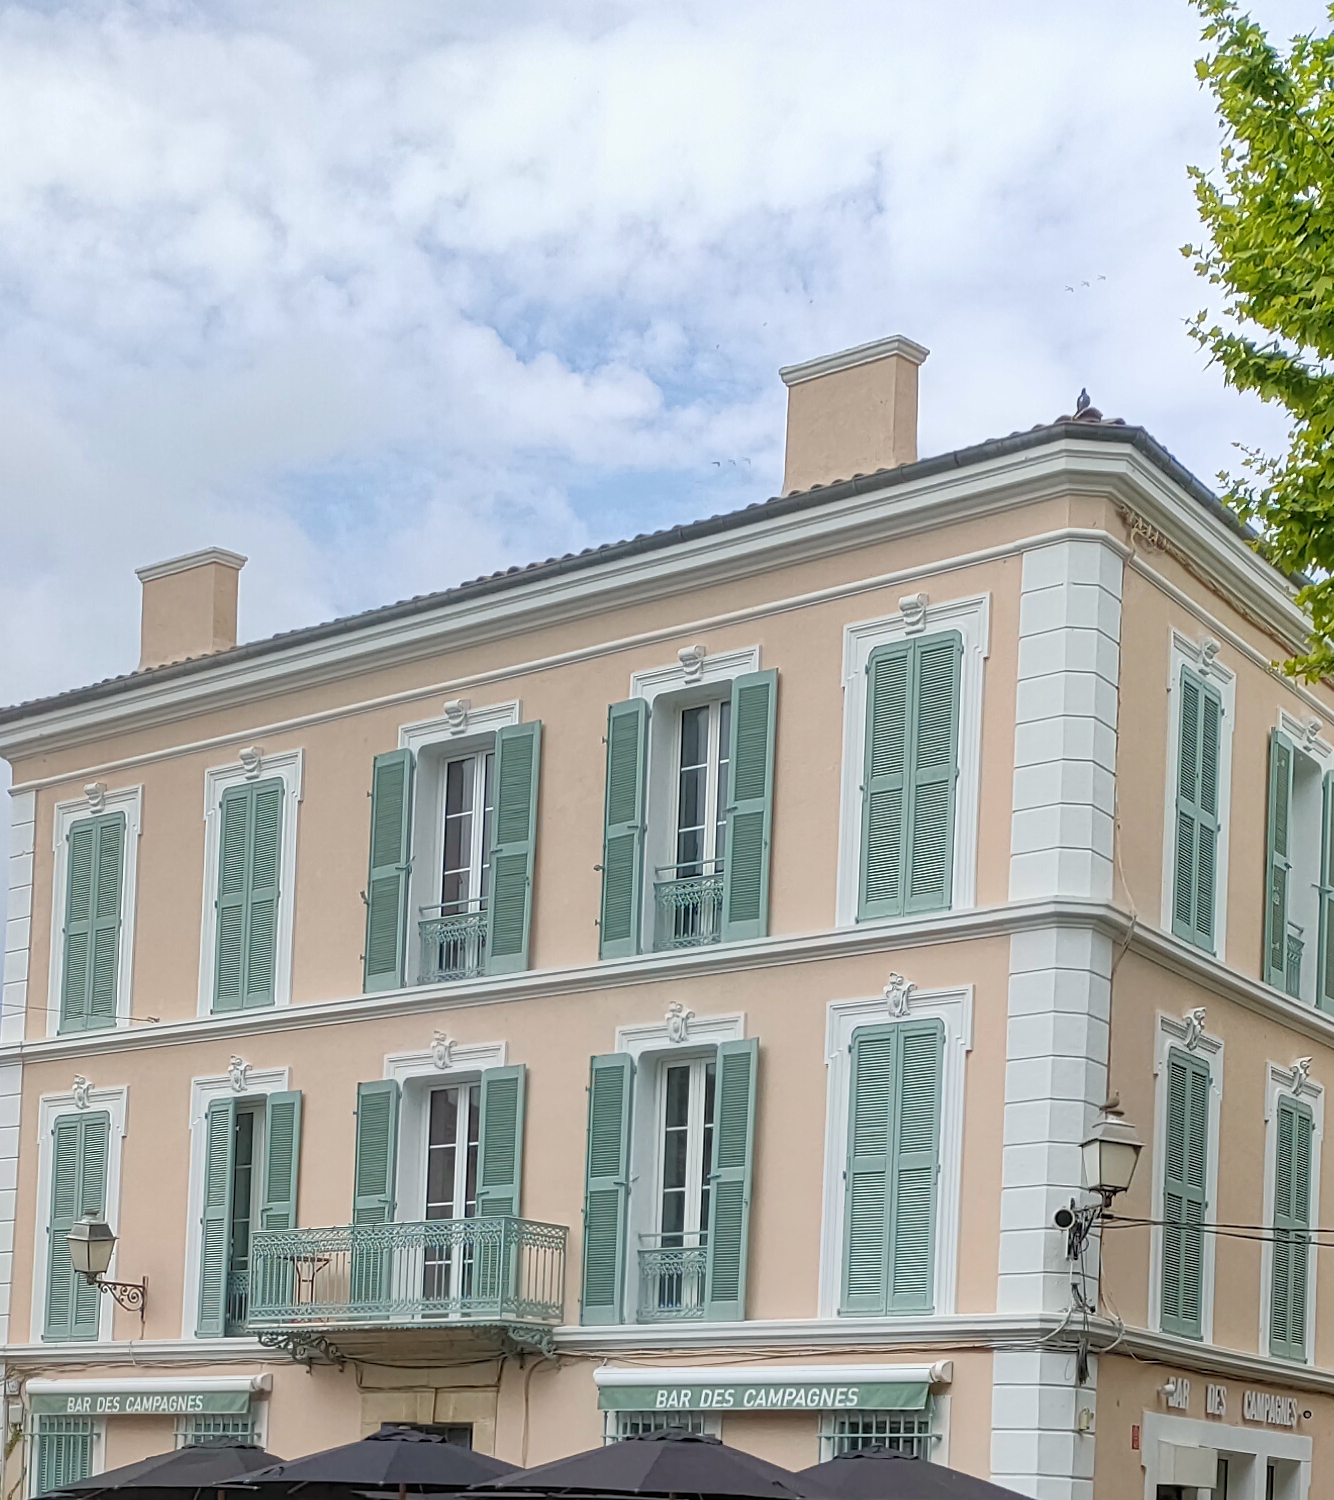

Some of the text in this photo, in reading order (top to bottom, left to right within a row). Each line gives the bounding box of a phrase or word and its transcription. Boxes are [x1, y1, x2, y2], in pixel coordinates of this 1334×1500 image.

[67, 1395, 204, 1412] BAR DES CAMPAGNES
[655, 1387, 860, 1408] BAR DES CAMPAGNES
[1167, 1376, 1299, 1427] BAR DES CAMPAGNES
